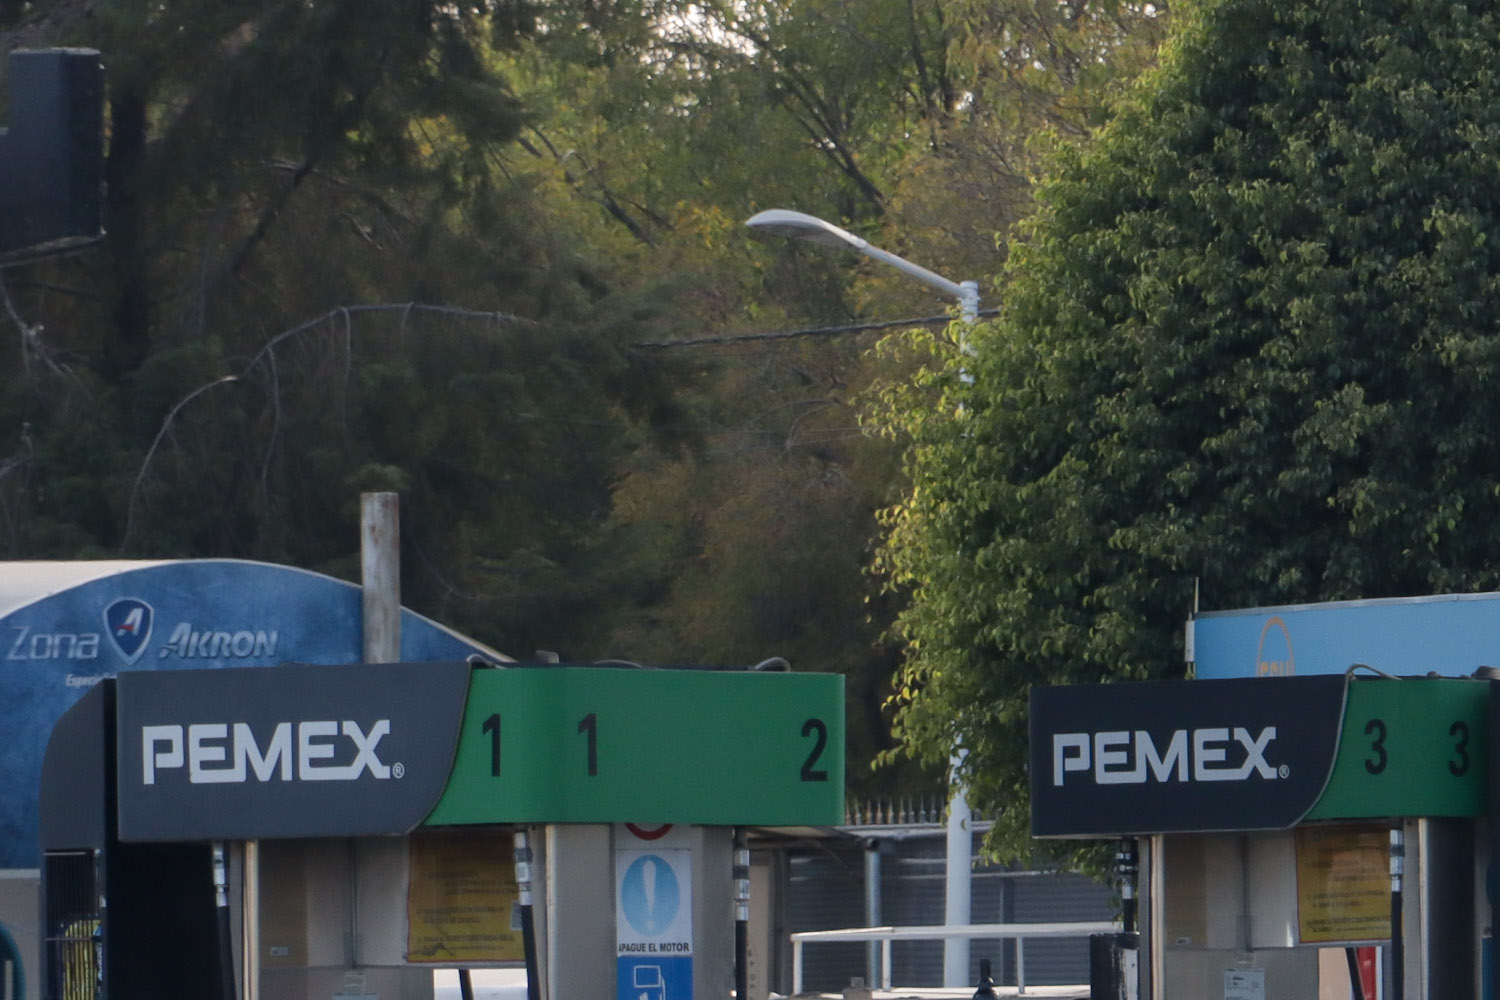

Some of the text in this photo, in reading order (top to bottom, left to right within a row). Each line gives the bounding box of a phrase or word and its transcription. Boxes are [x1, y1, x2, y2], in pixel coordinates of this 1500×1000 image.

[5, 625, 99, 662] Zona
[142, 712, 828, 785] PEMEX 1 1 2
[1053, 718, 1470, 786] PEMEX 3 3
[649, 943, 657, 952] EL
[660, 942, 689, 951] MOTOR
